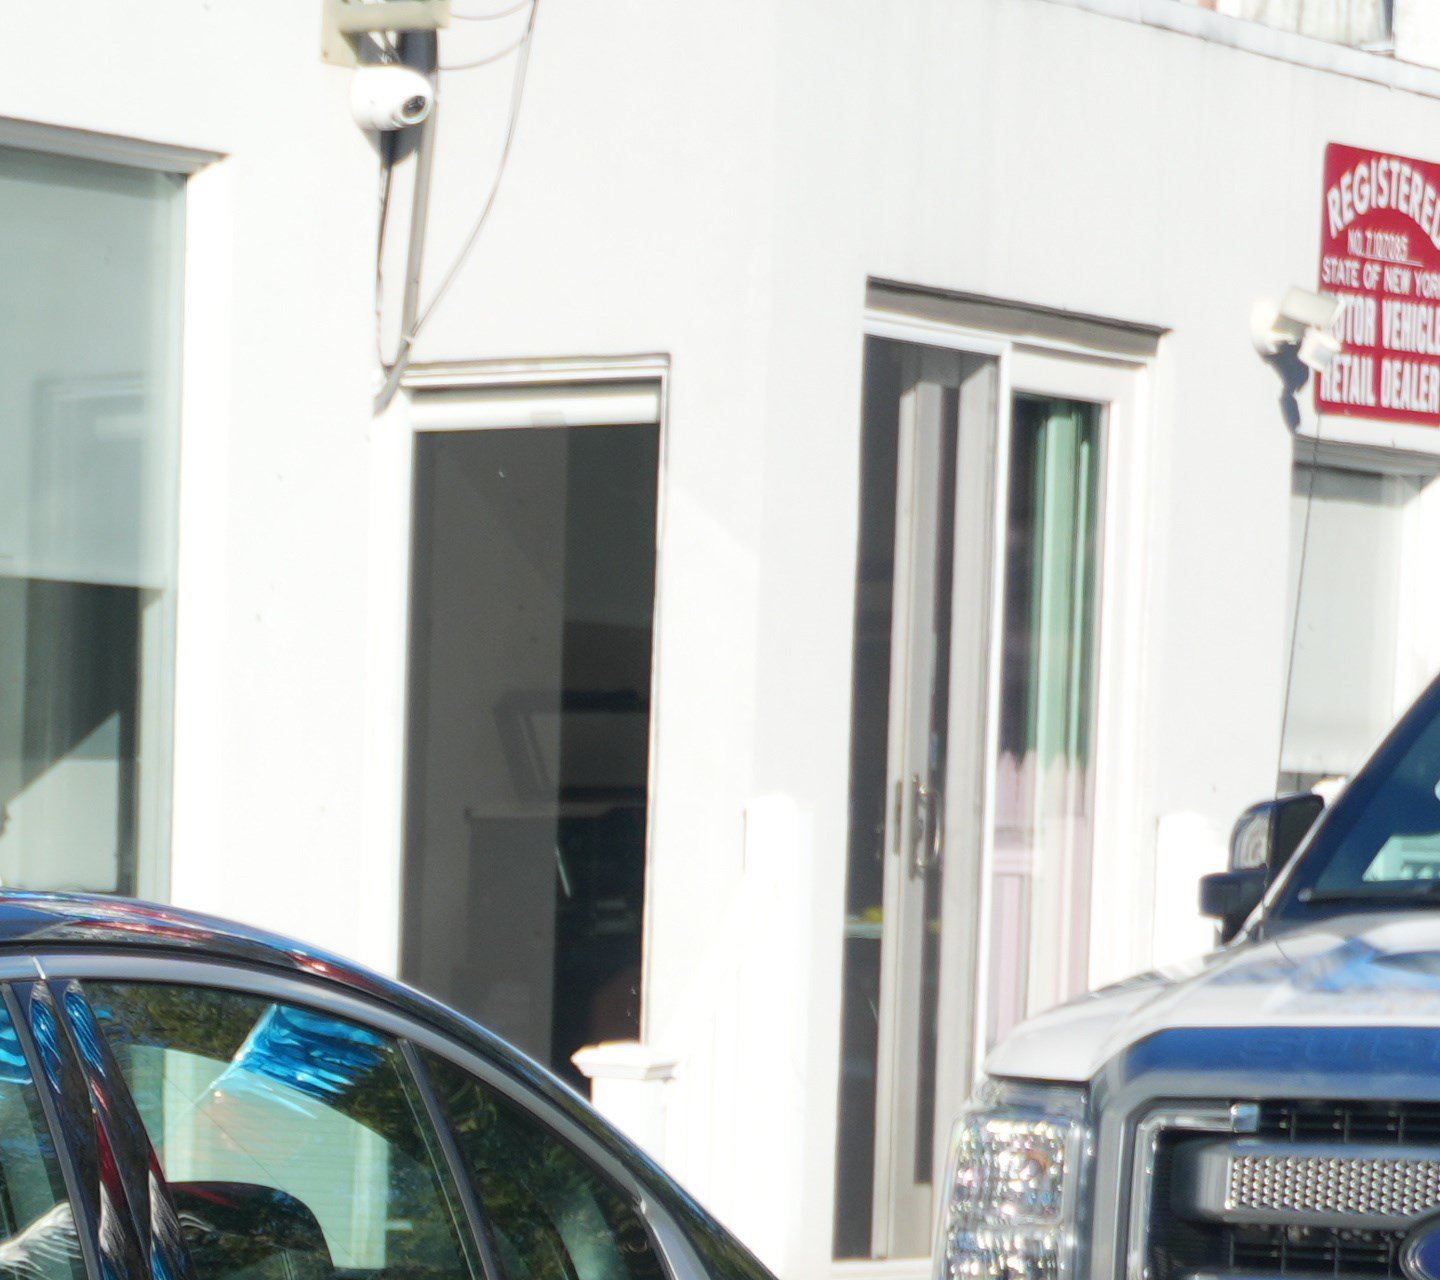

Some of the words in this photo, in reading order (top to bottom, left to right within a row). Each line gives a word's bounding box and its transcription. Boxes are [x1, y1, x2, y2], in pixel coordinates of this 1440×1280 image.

[1321, 255, 1360, 288] STATE
[1363, 261, 1382, 290] OF
[1383, 265, 1412, 295] NEW
[1324, 292, 1377, 347] OTOR
[1320, 353, 1376, 406] RETAIL
[1381, 358, 1440, 413] DEALER
